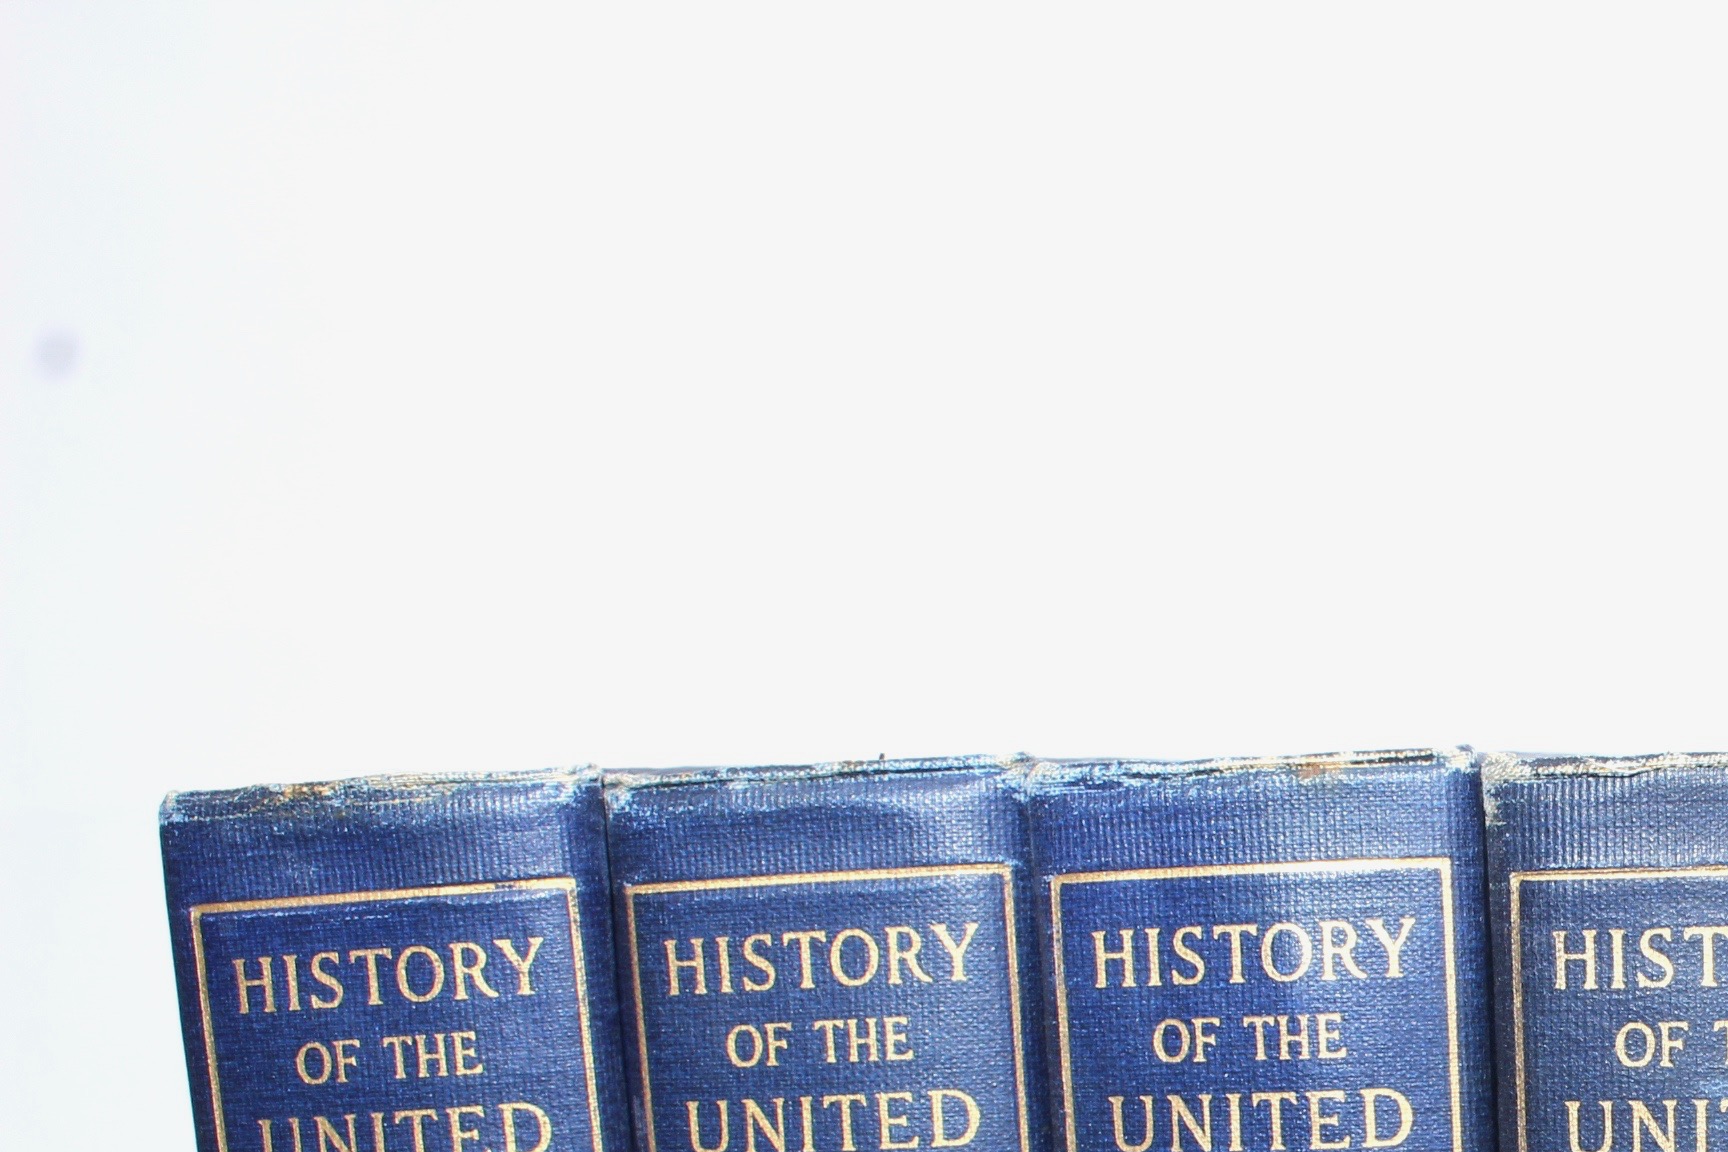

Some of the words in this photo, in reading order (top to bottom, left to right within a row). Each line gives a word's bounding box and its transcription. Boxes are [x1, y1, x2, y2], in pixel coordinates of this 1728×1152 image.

[234, 937, 540, 1013] HISTORY
[664, 923, 976, 995] HISTORY
[1093, 918, 1412, 987] HISTORY
[296, 1040, 358, 1084] OF
[383, 1032, 482, 1078] THE
[726, 1023, 790, 1067] OF
[814, 1016, 912, 1062] THE
[1153, 1018, 1219, 1061] OF
[1244, 1013, 1345, 1059] THE
[1615, 1022, 1687, 1066] OF
[1110, 1088, 1412, 1152] UNITED
